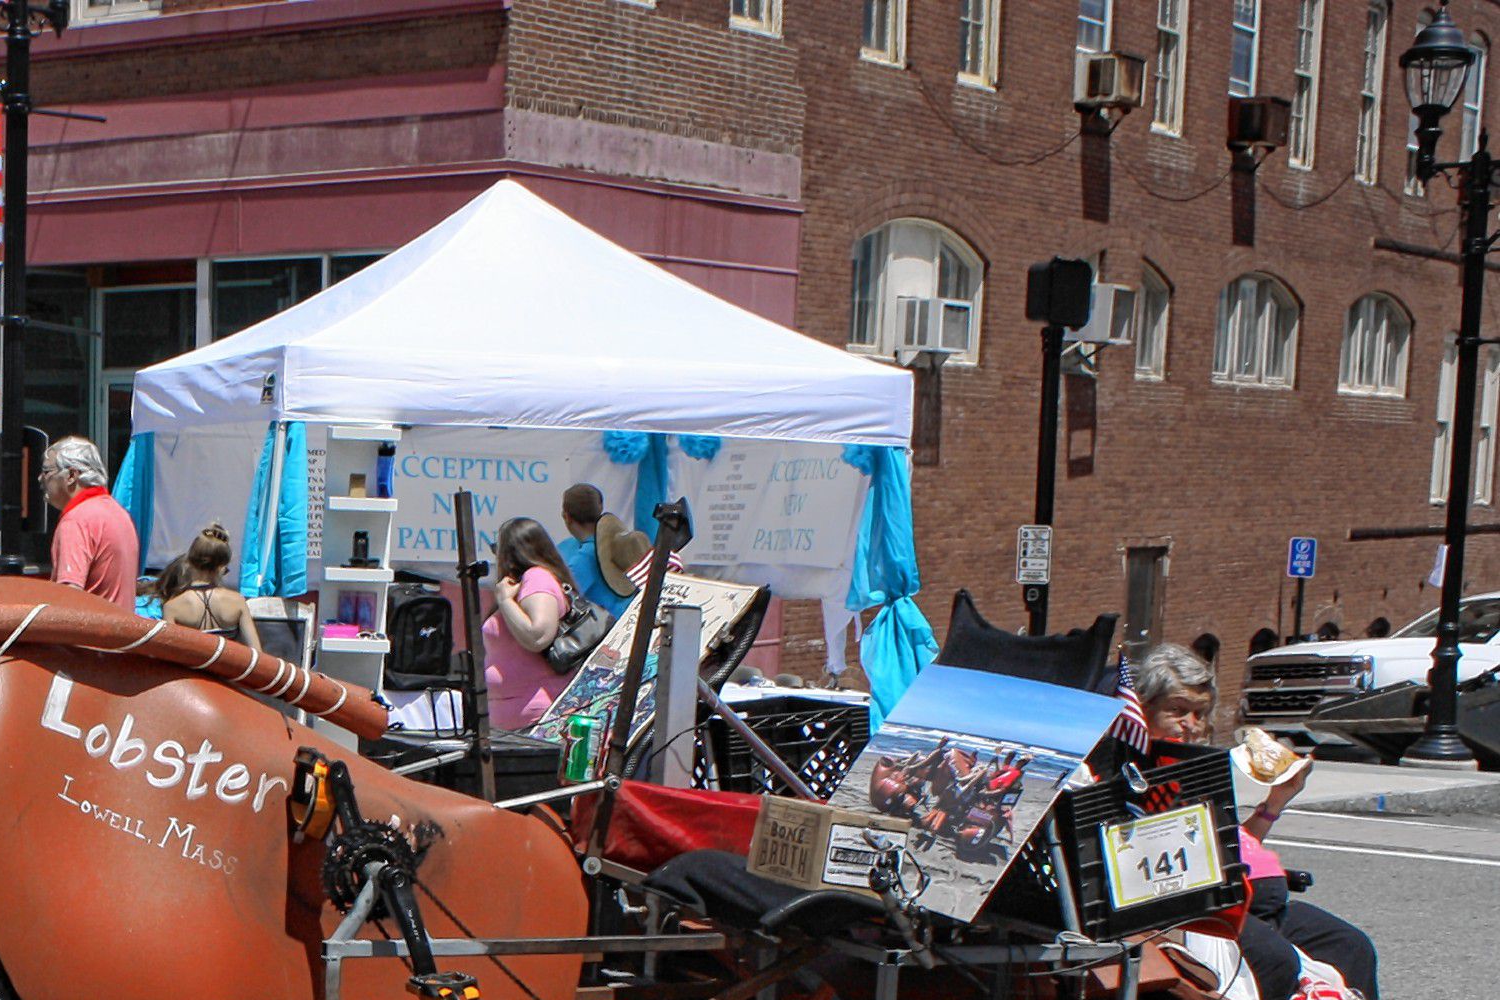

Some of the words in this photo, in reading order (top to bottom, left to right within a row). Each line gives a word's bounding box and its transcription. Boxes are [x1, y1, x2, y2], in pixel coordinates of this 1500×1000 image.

[432, 493, 498, 517] NW
[40, 671, 289, 813] Lobster
[770, 820, 807, 845] BONE
[757, 837, 808, 879] BROTH
[1136, 846, 1189, 882] 141
